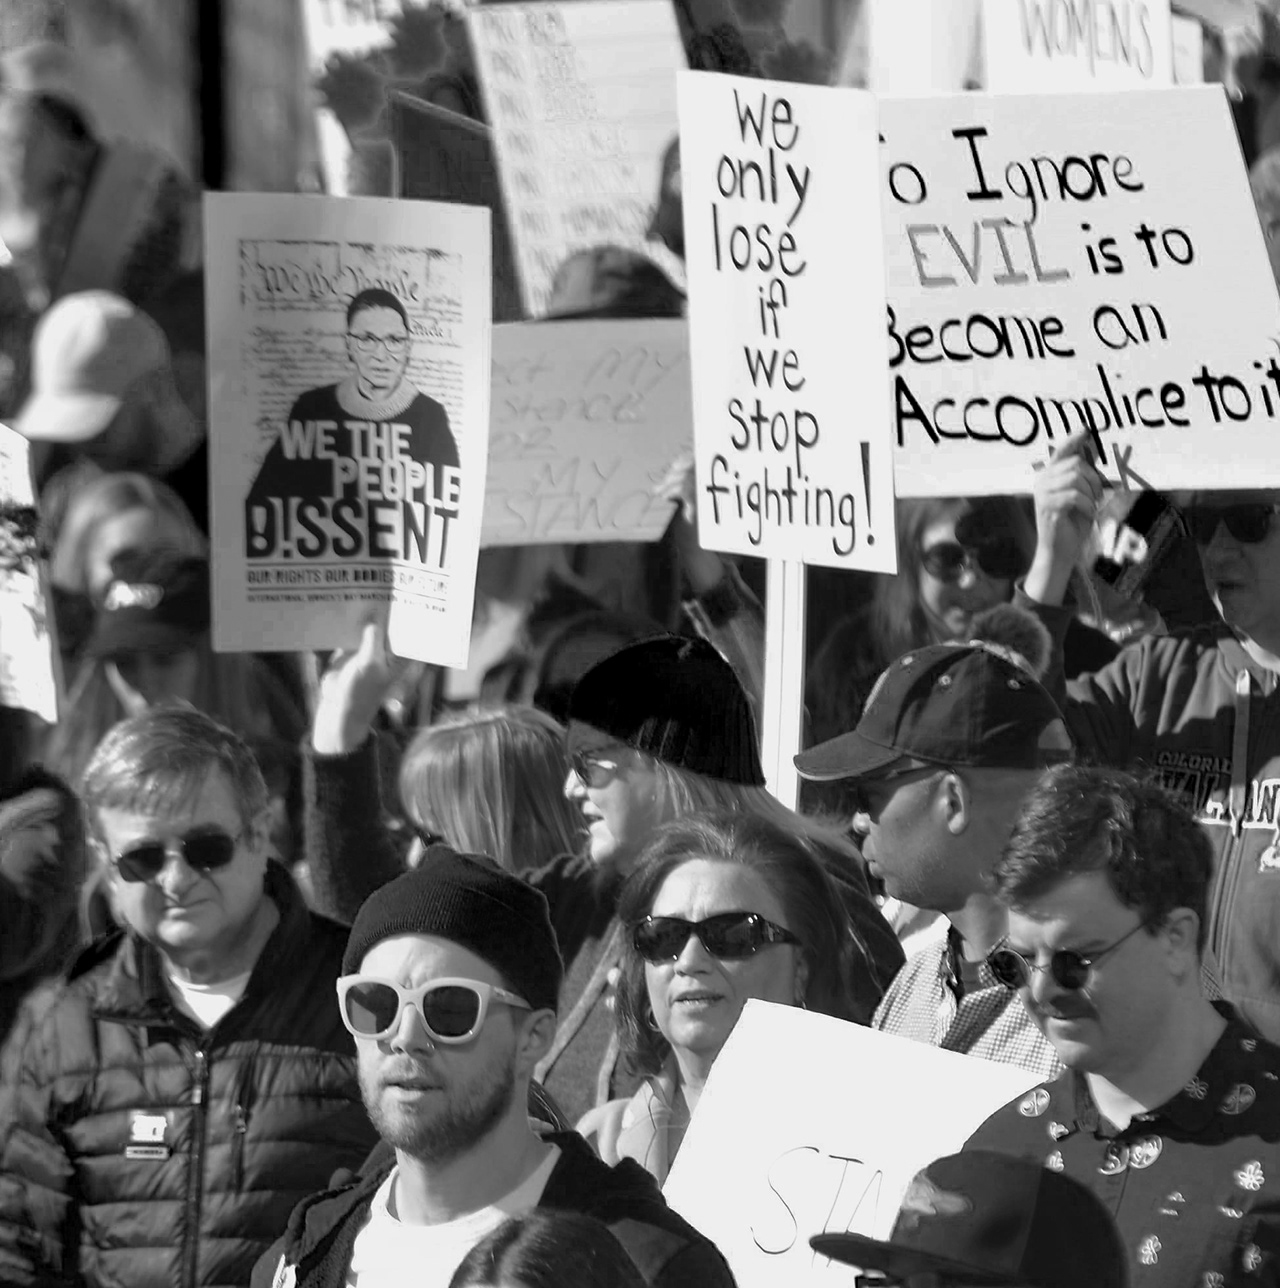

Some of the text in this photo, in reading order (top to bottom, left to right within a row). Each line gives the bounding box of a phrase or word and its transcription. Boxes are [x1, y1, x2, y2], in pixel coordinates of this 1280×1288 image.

[717, 146, 812, 227] only
[951, 126, 1144, 226] Ignore
[710, 201, 807, 278] lose
[906, 217, 1195, 288] EVIL is to
[758, 278, 789, 340] if
[886, 302, 1169, 368] Become an
[279, 419, 412, 463] WE THE
[893, 363, 1192, 466] Accomplice
[1191, 365, 1252, 423] to
[334, 458, 462, 510] PEOPLE
[705, 440, 877, 558] fighting!
[1157, 750, 1234, 777] COLORAD
